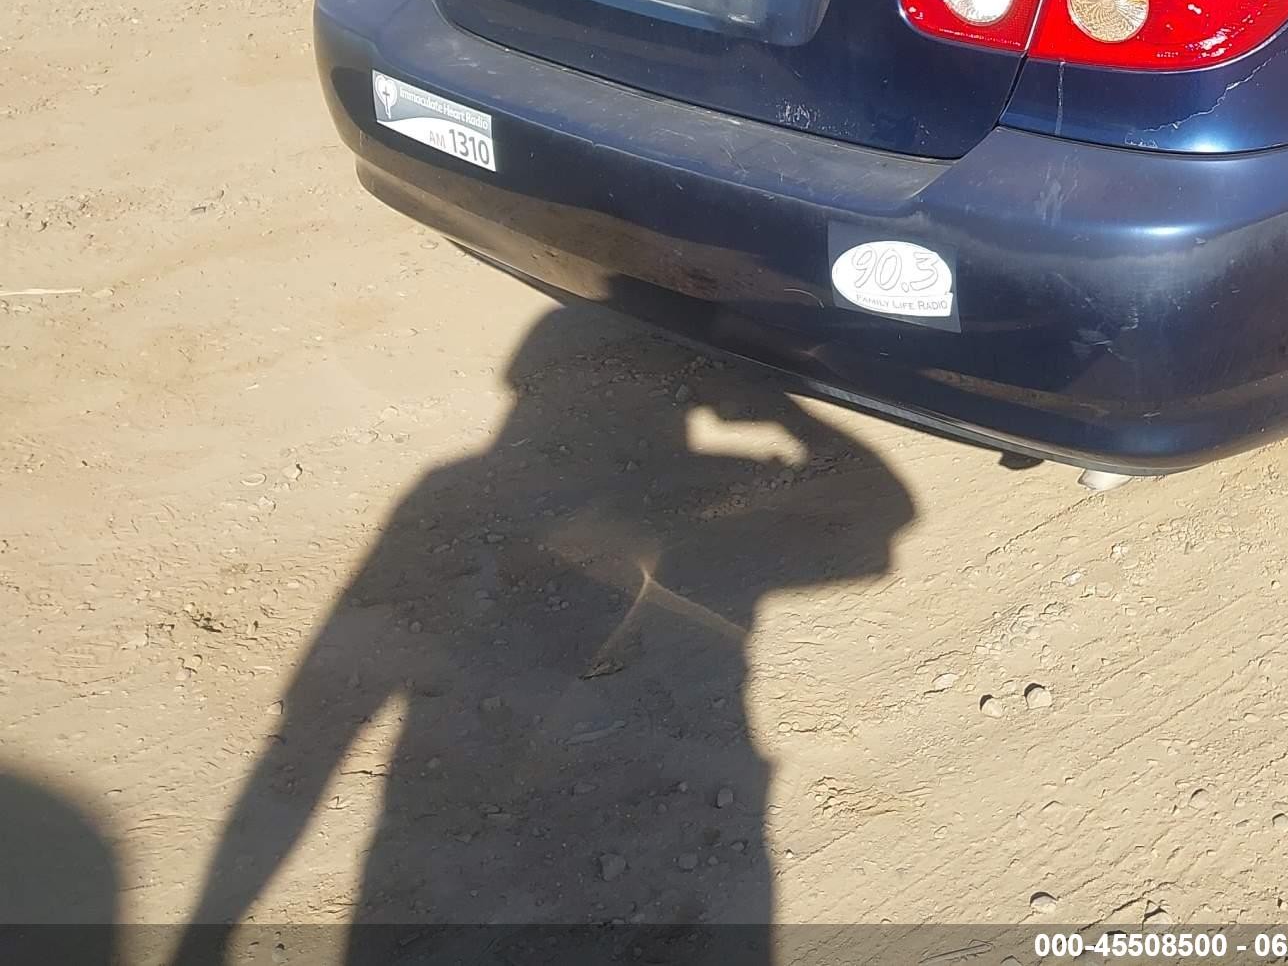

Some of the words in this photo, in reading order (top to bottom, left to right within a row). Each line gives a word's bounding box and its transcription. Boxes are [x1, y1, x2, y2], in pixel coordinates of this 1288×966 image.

[444, 103, 465, 121] Heart
[465, 111, 489, 130] Radio
[429, 130, 447, 149] AM
[449, 129, 490, 165] 1310
[851, 245, 939, 293] 90.3
